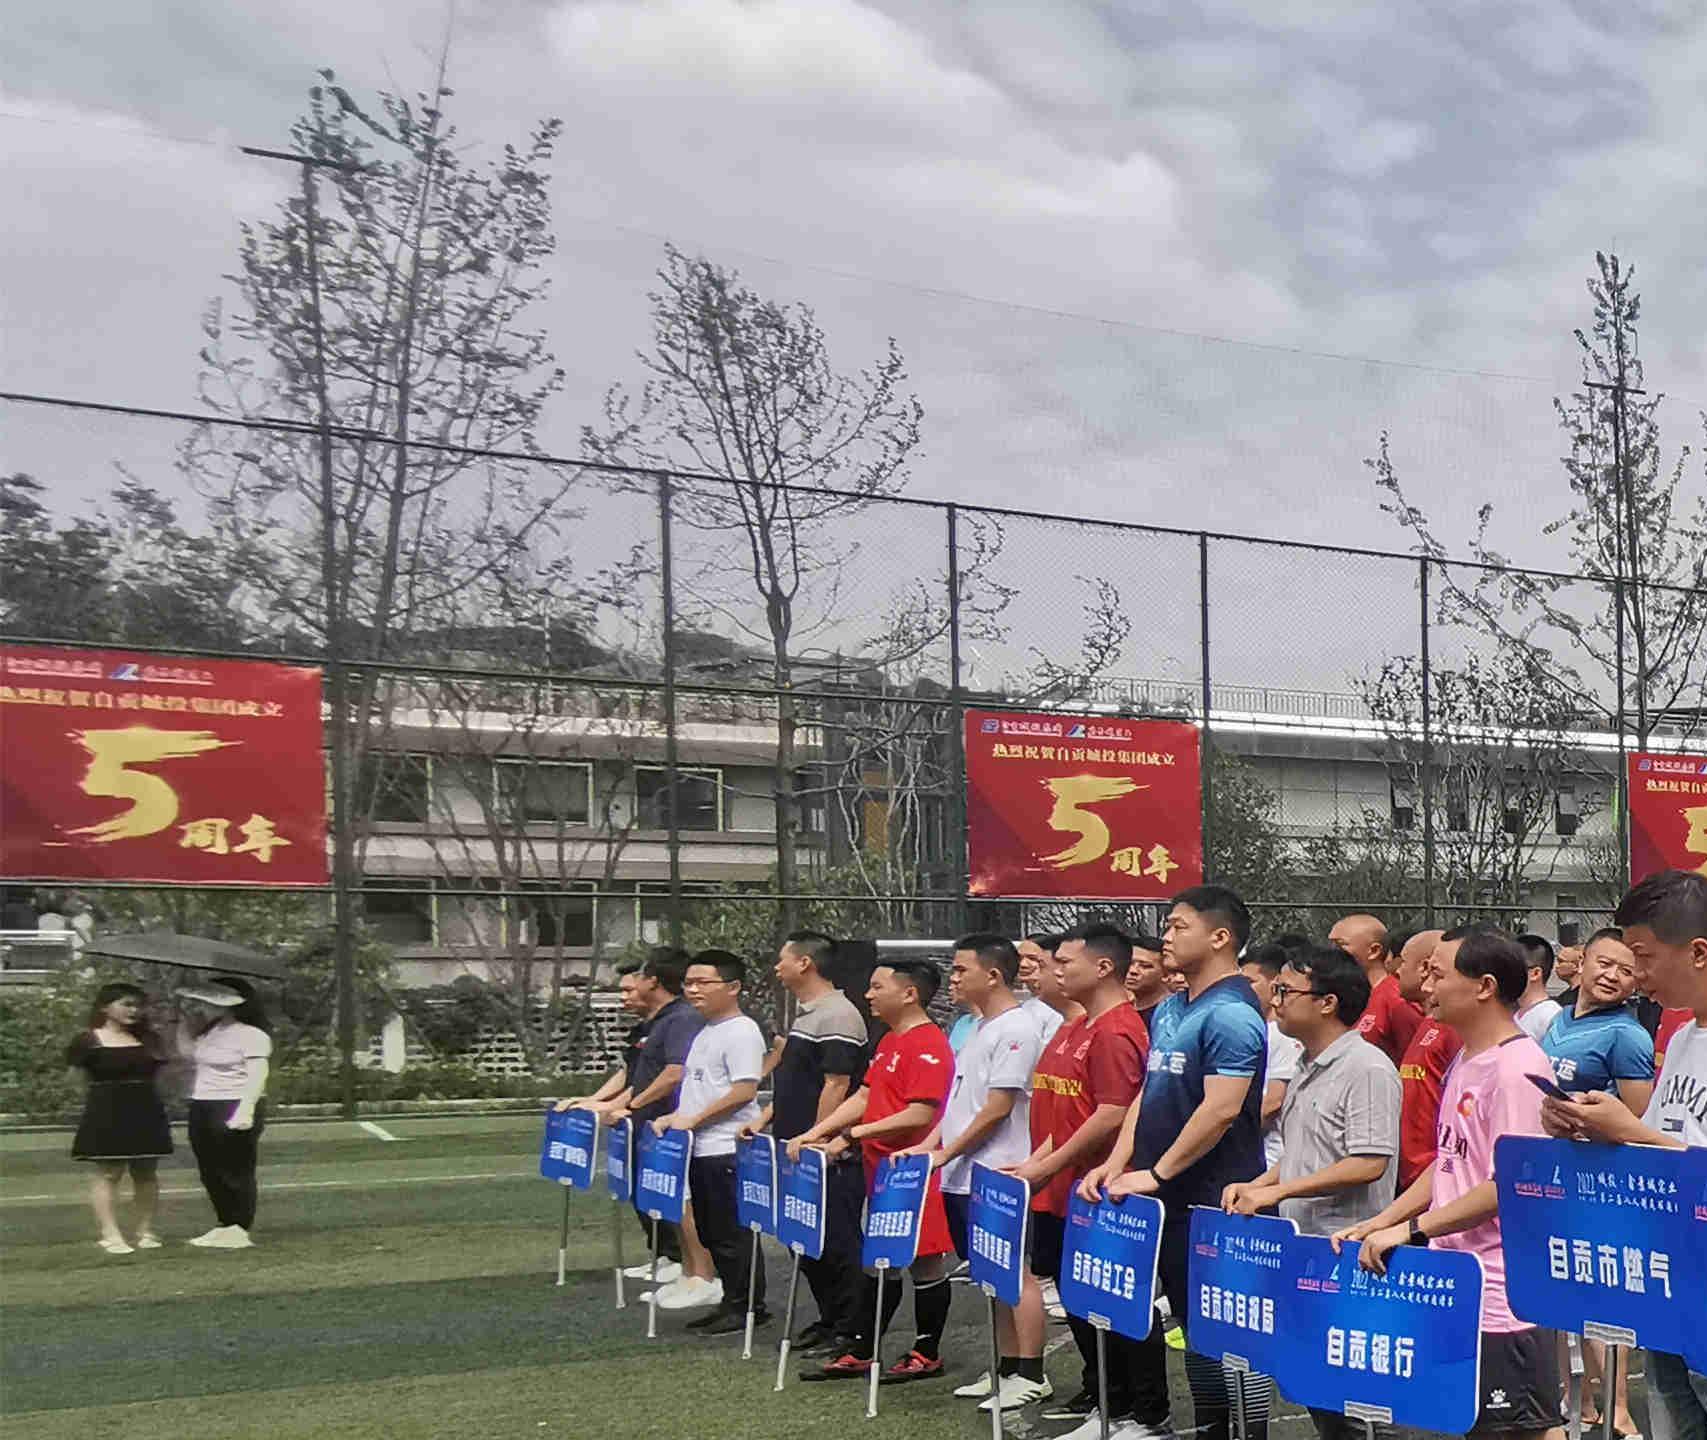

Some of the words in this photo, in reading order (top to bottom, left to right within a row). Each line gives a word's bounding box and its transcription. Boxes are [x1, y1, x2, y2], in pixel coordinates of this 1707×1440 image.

[54, 726, 245, 846] 5
[178, 813, 293, 863] 周年
[1030, 774, 1150, 870] 5
[1110, 844, 1179, 884] 周年
[1548, 1235, 1672, 1299] 自贡市燃气
[1327, 1326, 1415, 1378] 自贡银行
